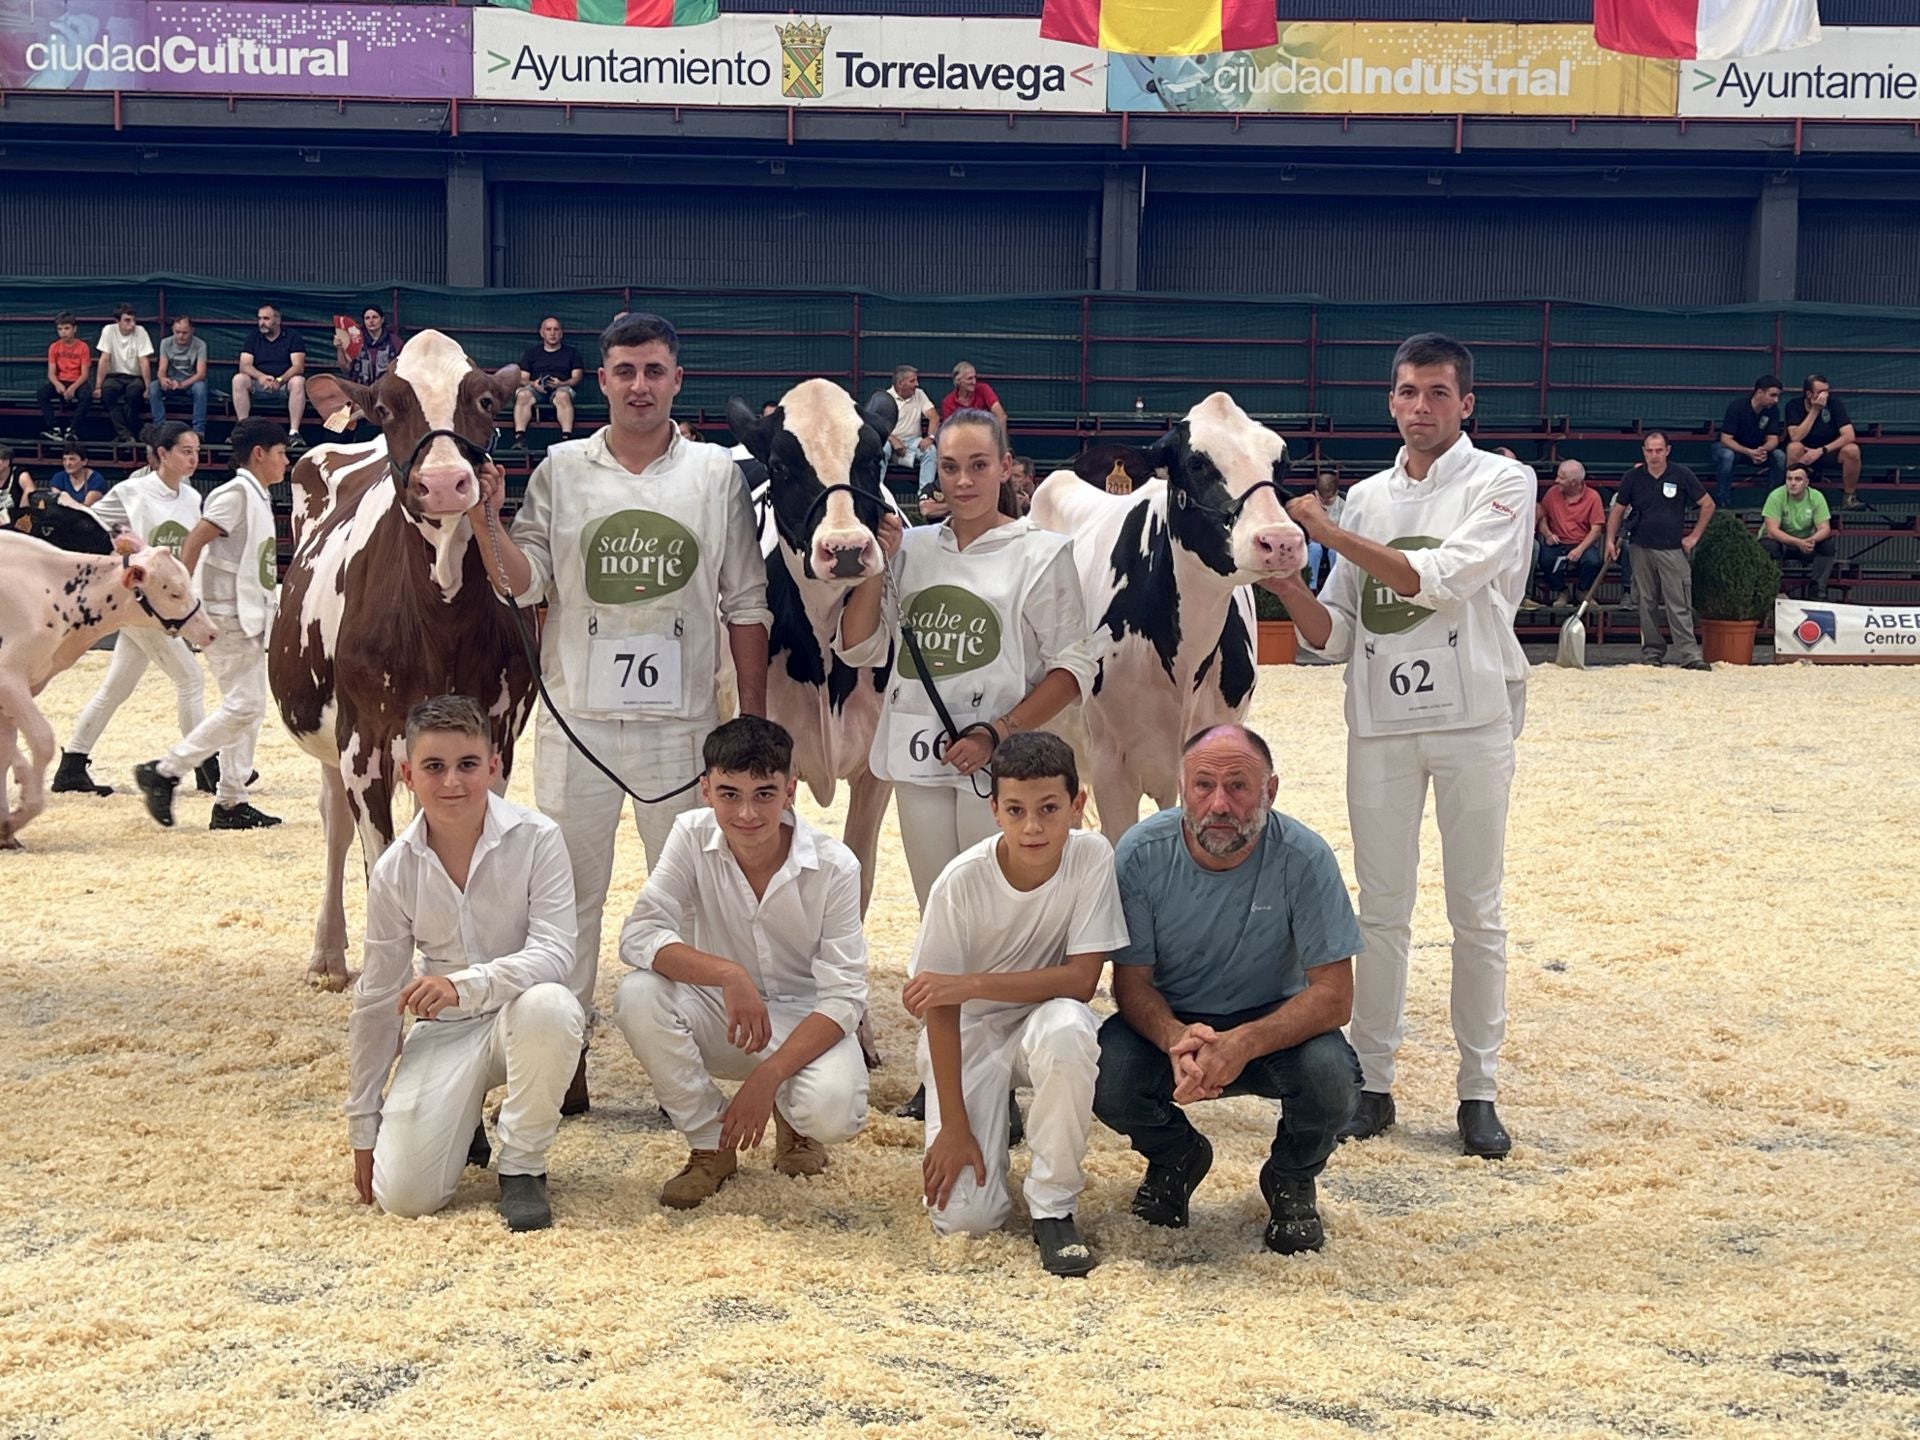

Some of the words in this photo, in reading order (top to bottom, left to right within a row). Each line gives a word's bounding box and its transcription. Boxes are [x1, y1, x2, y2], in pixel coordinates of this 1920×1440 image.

[25, 34, 349, 77] ciudadCultural
[511, 44, 771, 91] Ayuntamiento
[836, 51, 1066, 101] Torrelavega
[1212, 57, 1570, 96] ciudadIndustrial
[598, 527, 659, 553] sabe
[667, 538, 685, 556] a
[600, 553, 684, 587] norte
[969, 616, 987, 635] a
[1864, 631, 1917, 645] Centro
[613, 653, 660, 688] 76
[1389, 658, 1435, 696] 62
